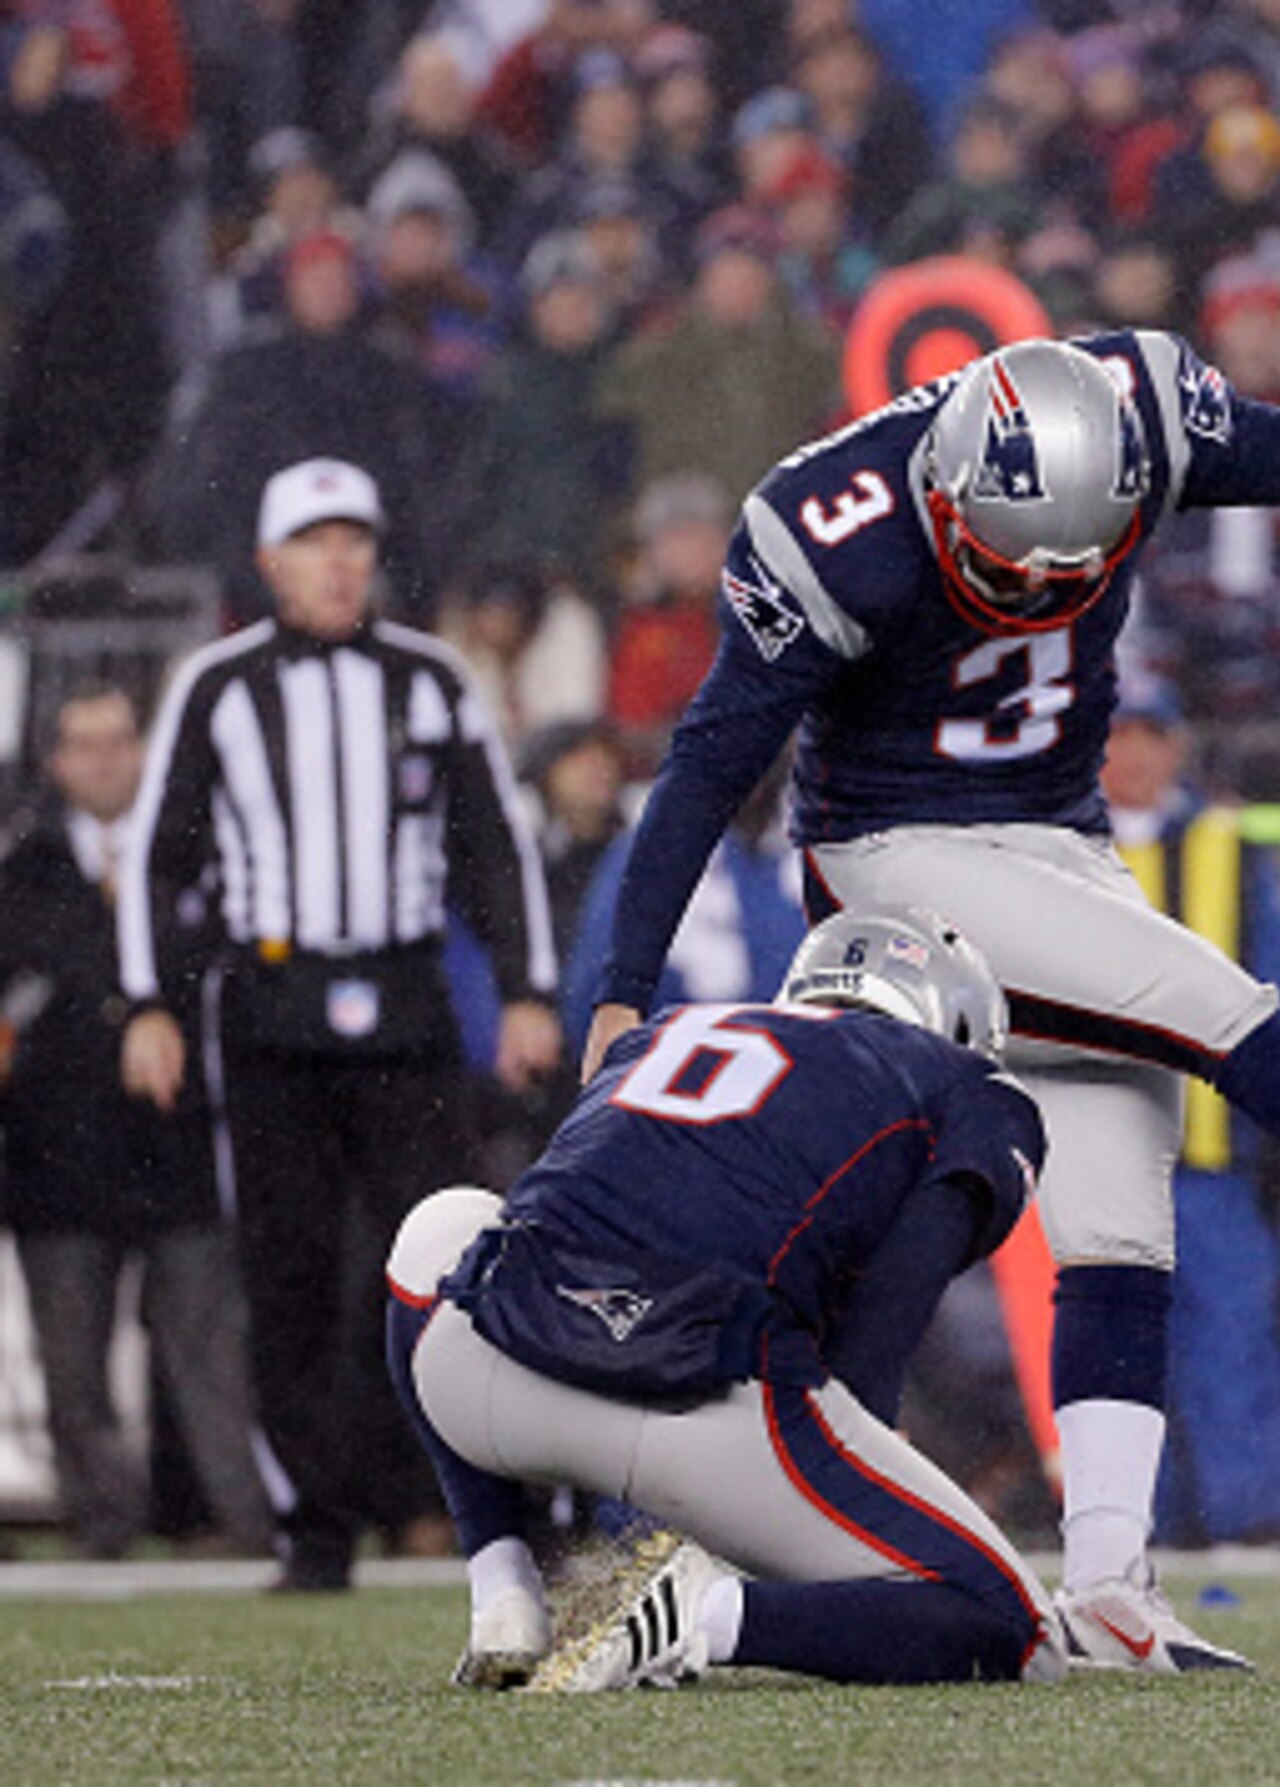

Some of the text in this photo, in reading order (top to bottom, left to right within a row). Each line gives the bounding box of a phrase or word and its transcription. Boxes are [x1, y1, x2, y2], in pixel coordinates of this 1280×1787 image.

[800, 466, 895, 547] 3
[932, 625, 1077, 759] 3
[843, 937, 870, 966] 6
[607, 1003, 845, 1125] 6
